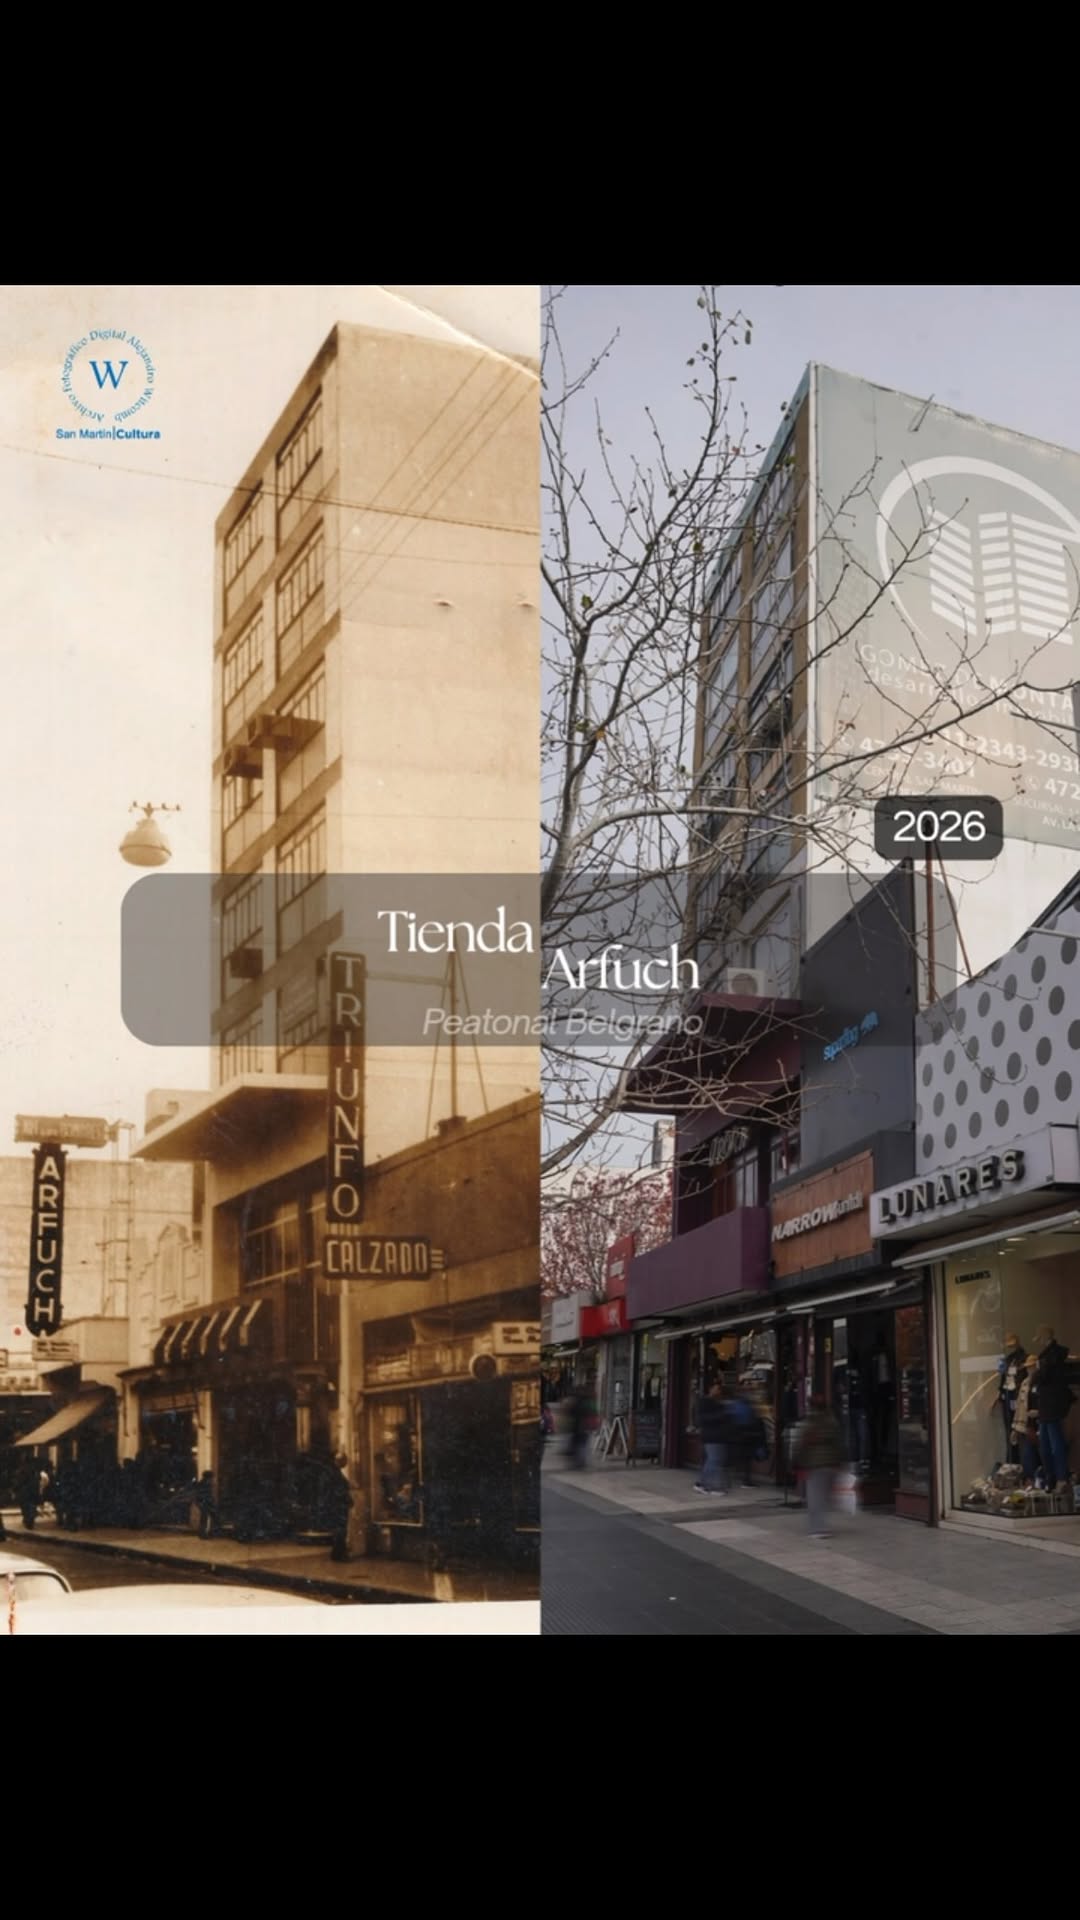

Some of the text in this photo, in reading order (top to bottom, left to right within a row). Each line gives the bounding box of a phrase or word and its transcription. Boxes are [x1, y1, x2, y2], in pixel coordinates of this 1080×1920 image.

[332, 955, 361, 1218] TRIUNFO
[33, 1156, 61, 1323] ARFUCH
[879, 1149, 1025, 1224] LUNARES
[326, 1240, 428, 1274] CALZADO
